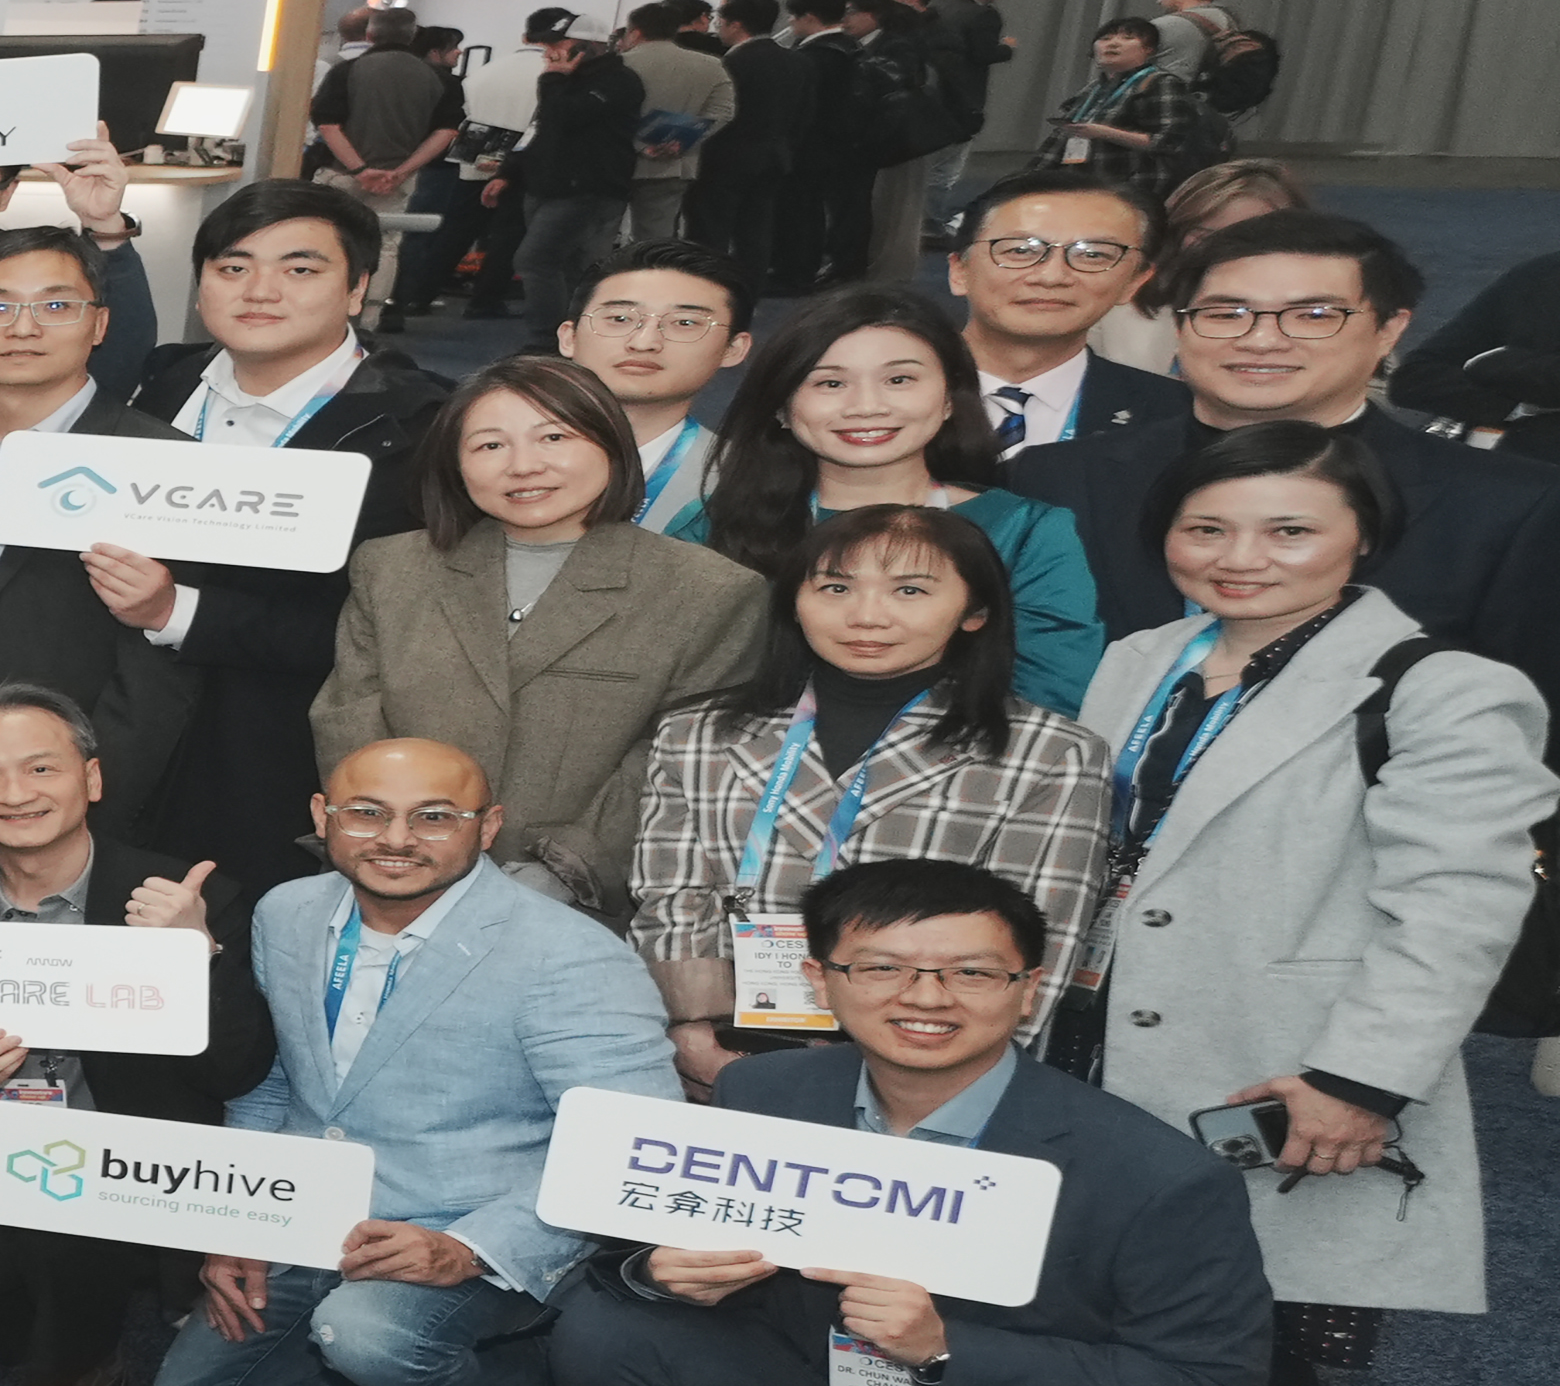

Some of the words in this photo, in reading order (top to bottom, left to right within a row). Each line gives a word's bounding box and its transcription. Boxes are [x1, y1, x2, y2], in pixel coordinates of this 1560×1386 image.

[129, 482, 305, 518] VCARE
[84, 981, 166, 1011] LAB
[99, 1148, 297, 1202] buyhive
[627, 1136, 966, 1226] DENTOMI
[97, 1190, 185, 1213] sourcing
[186, 1198, 241, 1219] made
[245, 1208, 293, 1228] easy
